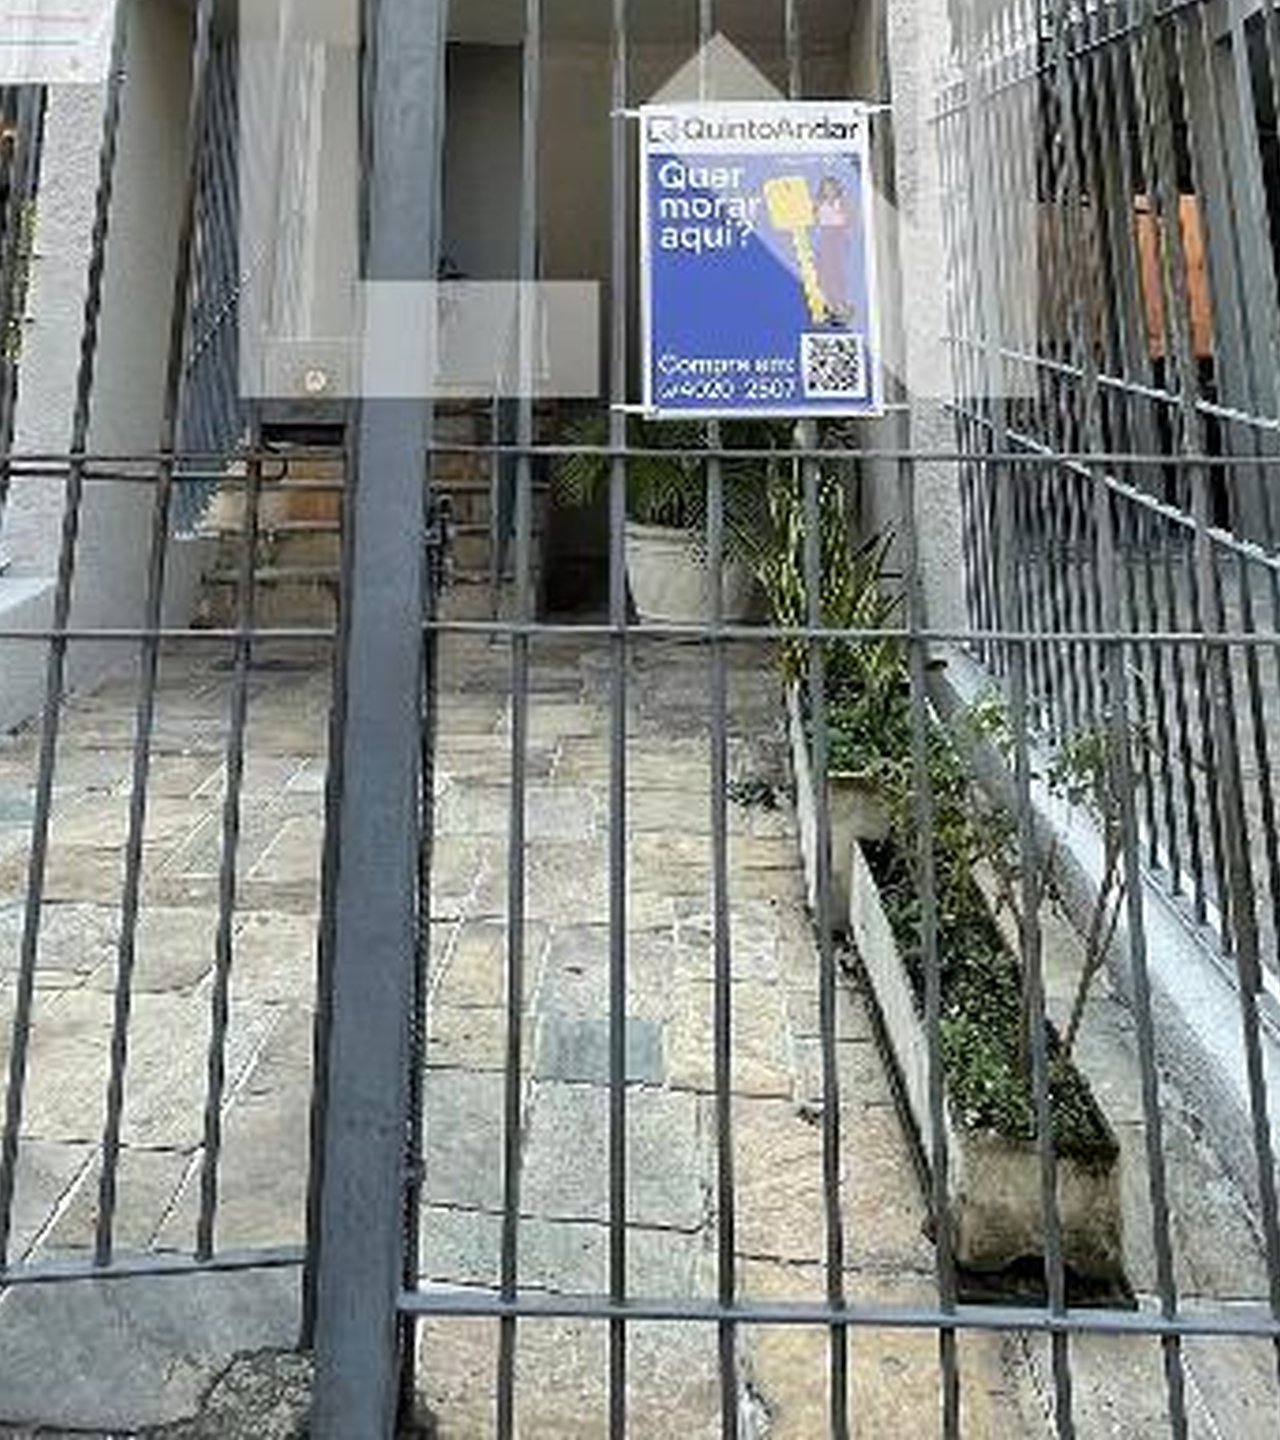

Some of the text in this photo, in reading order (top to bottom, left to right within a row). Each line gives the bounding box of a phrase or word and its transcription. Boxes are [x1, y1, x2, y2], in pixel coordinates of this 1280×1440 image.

[684, 117, 859, 141] QuintoAndar
[658, 161, 745, 191] Quer
[660, 197, 761, 219] morar
[660, 219, 754, 254] aqui?
